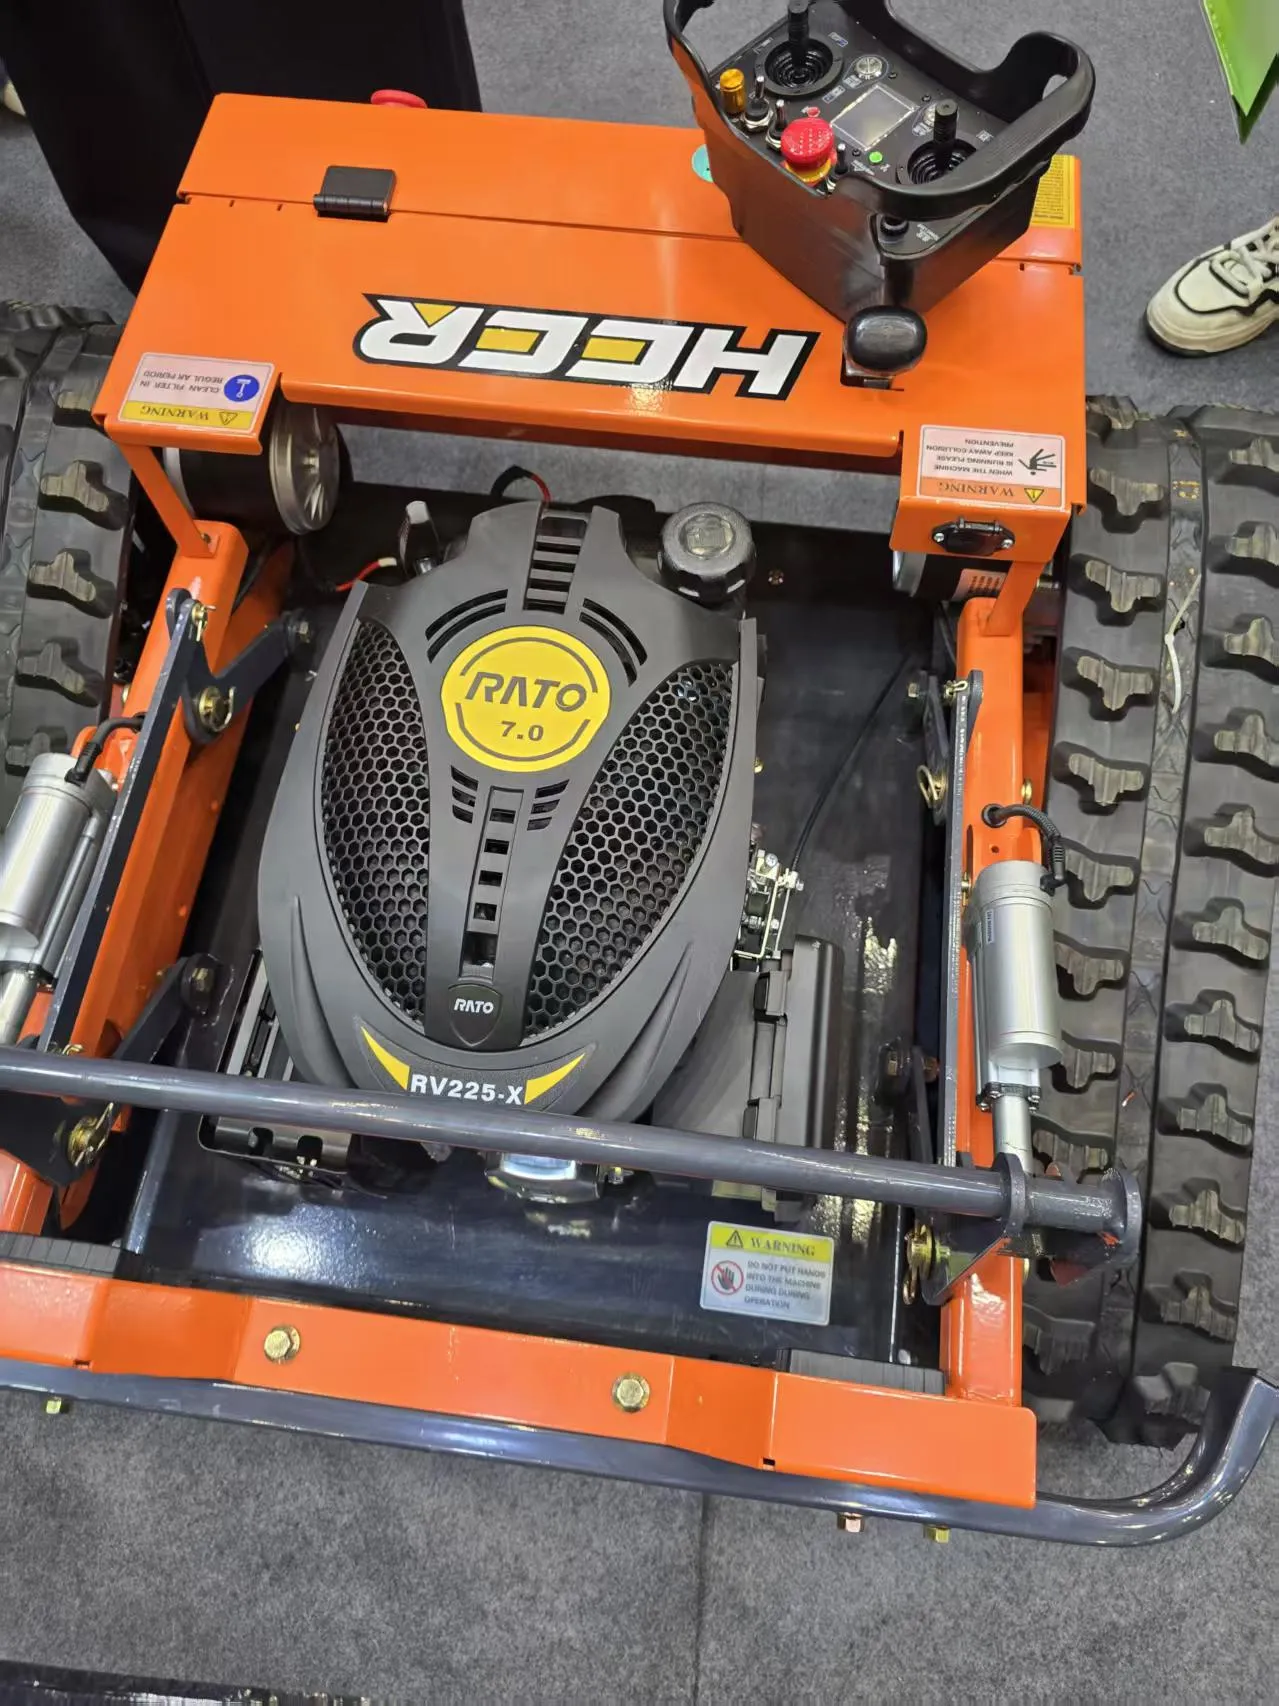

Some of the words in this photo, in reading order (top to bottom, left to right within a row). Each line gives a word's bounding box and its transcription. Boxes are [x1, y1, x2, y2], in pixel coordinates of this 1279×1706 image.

[143, 370, 177, 380] PERIOD
[139, 380, 151, 388] IN
[154, 382, 185, 391] FILTER
[189, 384, 220, 394] CLEAN
[141, 406, 209, 420] WARNING
[964, 438, 1014, 448] PREVENTION
[925, 444, 967, 454] COLLISION
[967, 448, 993, 457] AWAY
[936, 455, 965, 464] PLEASE
[967, 457, 1004, 466] RUNNING
[933, 464, 971, 474] MACHINE
[971, 466, 987, 475] THE
[988, 468, 1013, 477] WHEN
[939, 482, 1014, 497] WARNING
[464, 670, 588, 713] RATO
[499, 720, 545, 742] 7.0
[453, 998, 495, 1015] RATO
[410, 1073, 524, 1106] RV225-X
[751, 1238, 815, 1256] WARNING
[747, 1260, 760, 1270] DO
[761, 1262, 779, 1272] NOT
[780, 1264, 796, 1274] PUT
[797, 1266, 827, 1279] HANDS
[746, 1272, 767, 1283] INTO
[767, 1274, 783, 1285] THE
[784, 1277, 822, 1291] MACHINE
[745, 1284, 777, 1297] DURING
[778, 1288, 811, 1301] DURING
[743, 1296, 791, 1311] OPERATION
